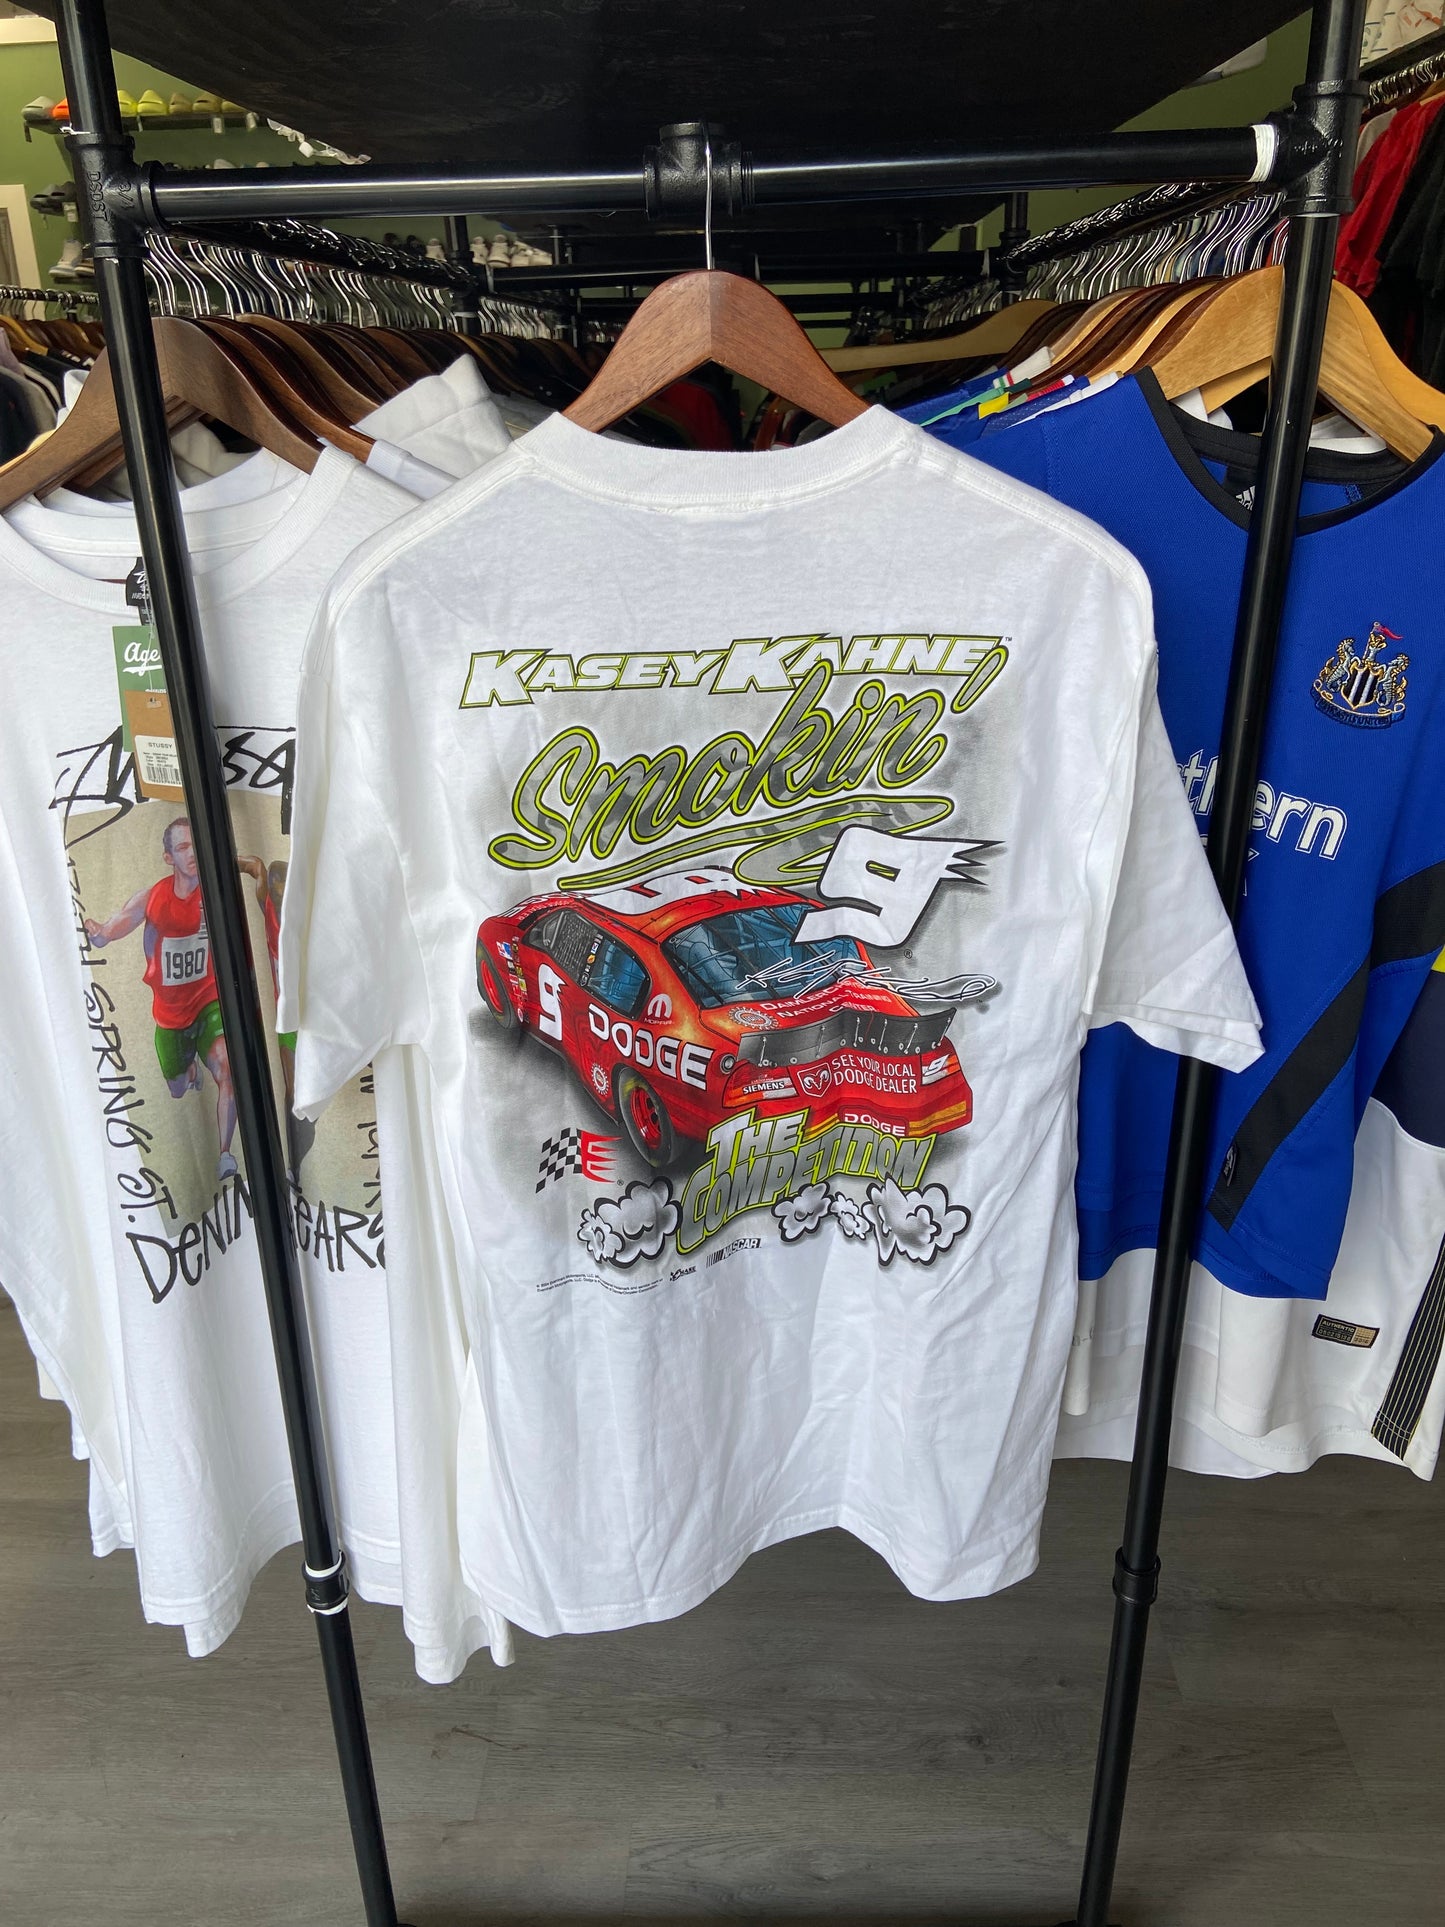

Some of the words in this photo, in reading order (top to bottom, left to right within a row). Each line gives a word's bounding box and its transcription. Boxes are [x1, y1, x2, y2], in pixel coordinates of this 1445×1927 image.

[460, 648, 727, 709] KASEY
[709, 633, 1004, 695] KAHNE
[791, 823, 1006, 950] 9
[165, 947, 206, 979] 1980
[538, 963, 570, 1041] 9
[588, 1003, 715, 1091] DODGE
[831, 1055, 855, 1069] SEE
[856, 1056, 881, 1073] YOUR
[882, 1063, 916, 1077] LOCAL
[743, 1081, 785, 1095] SIEMENS
[833, 1069, 875, 1088] DODGE
[875, 1077, 918, 1093] DEALER
[706, 1107, 810, 1178] THE
[844, 1113, 906, 1136] DODGE
[676, 1122, 938, 1255] COMPETITION
[721, 1238, 761, 1259] NASCAR
